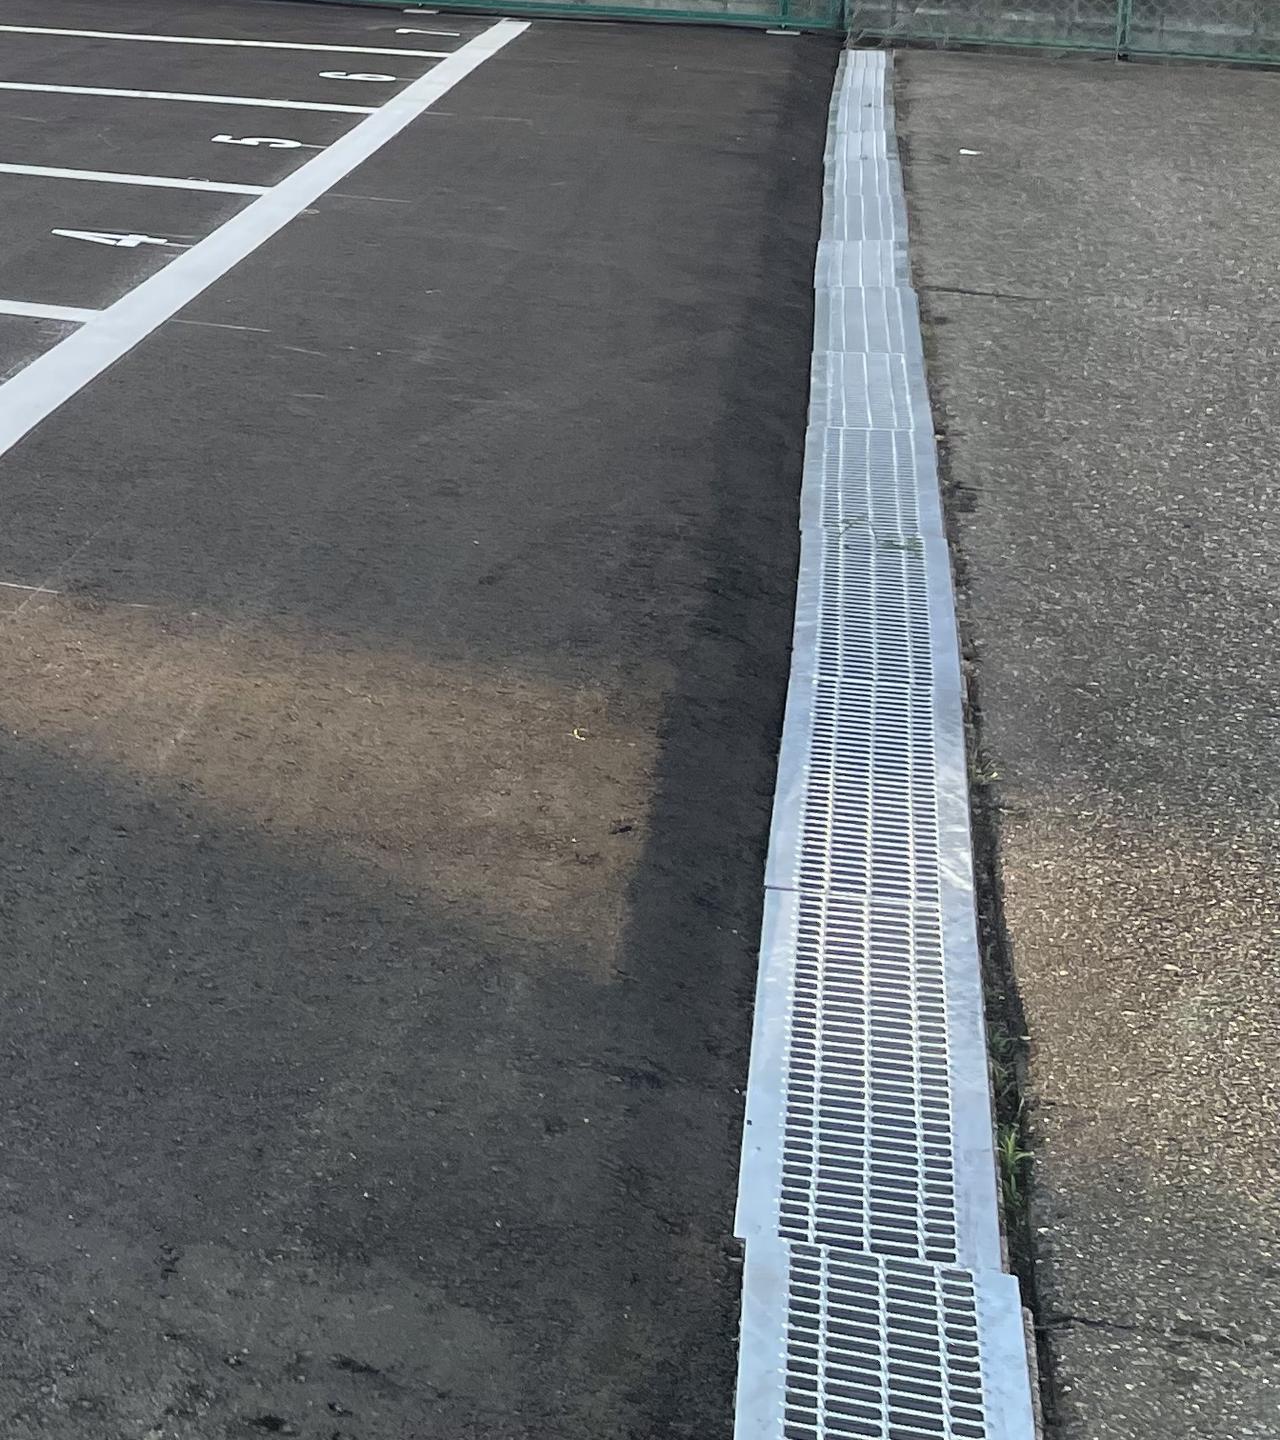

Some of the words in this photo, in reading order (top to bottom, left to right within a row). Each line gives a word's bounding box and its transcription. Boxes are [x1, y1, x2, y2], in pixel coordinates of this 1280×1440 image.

[318, 71, 397, 82] 6
[211, 134, 303, 149] 5
[51, 229, 170, 248] 4
